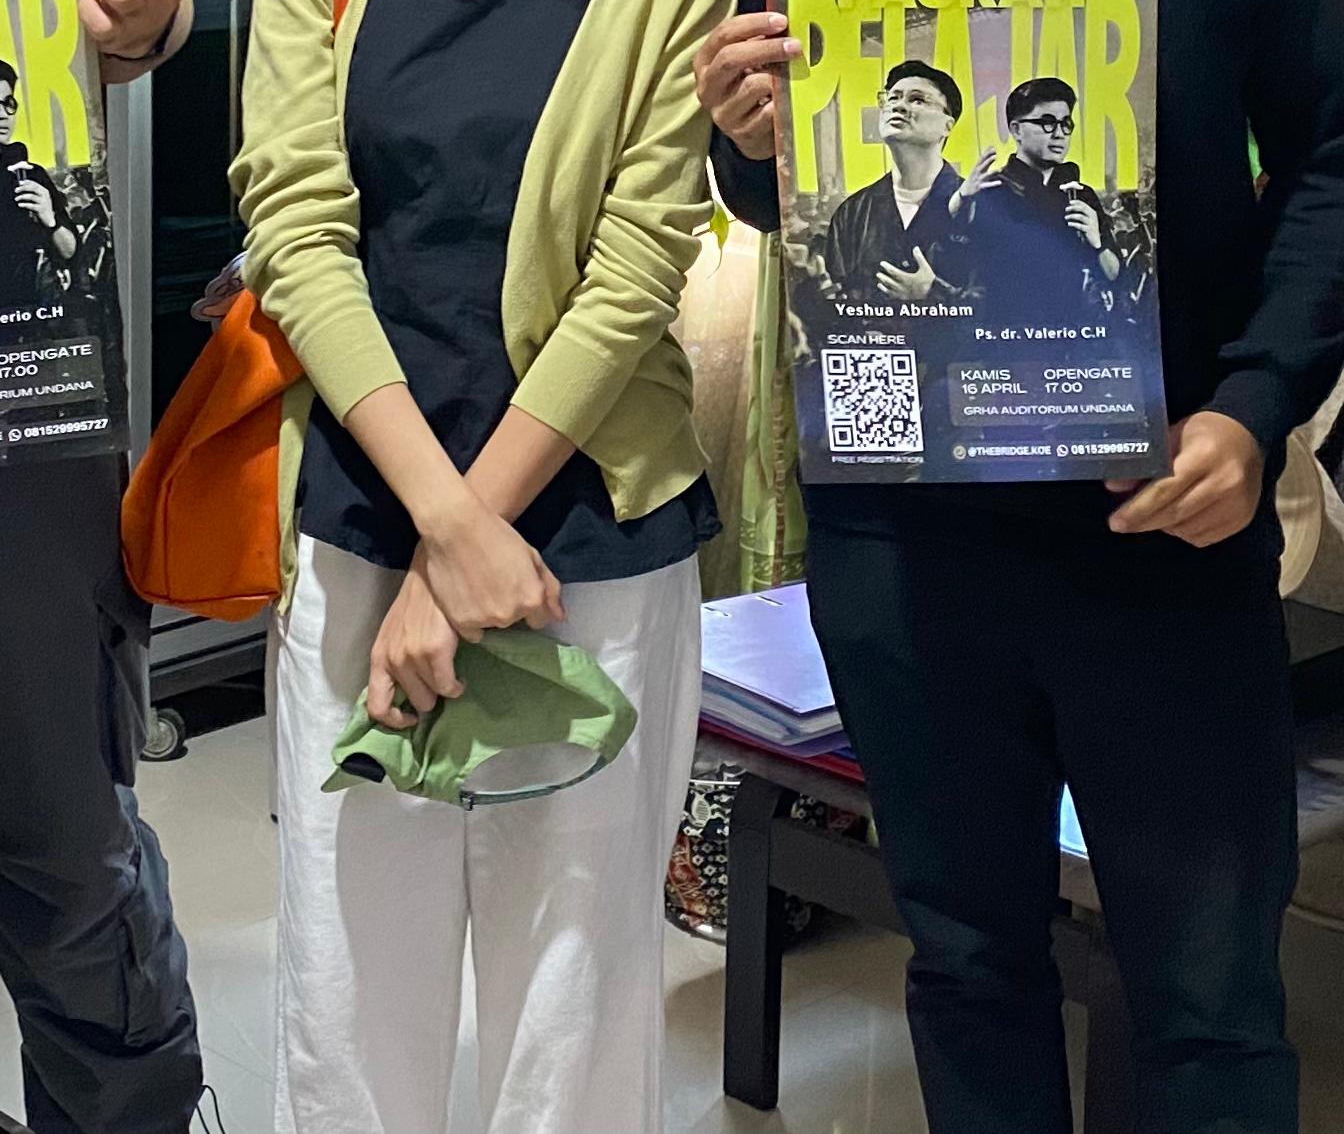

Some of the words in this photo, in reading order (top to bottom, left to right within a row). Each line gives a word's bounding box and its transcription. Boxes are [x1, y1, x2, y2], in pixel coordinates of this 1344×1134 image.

[36, 306, 64, 320] C.H
[835, 303, 894, 316] Yeshua
[900, 303, 973, 316] Abraham
[827, 334, 866, 345] SCAN
[868, 334, 906, 345] HERE
[975, 328, 997, 340] Ps.
[1000, 328, 1021, 340] dr.
[1024, 327, 1077, 339] Valerio
[1080, 326, 1106, 339] C.H
[960, 369, 1011, 381] KAMIS
[1043, 367, 1132, 380] OPENGATE
[35, 380, 95, 396] UNDANA
[962, 383, 978, 395] 16
[981, 383, 1027, 394] APRIL
[963, 406, 999, 416] GRHA
[1001, 405, 1079, 415] AUDITORIUM
[1080, 403, 1135, 414] UNDANA
